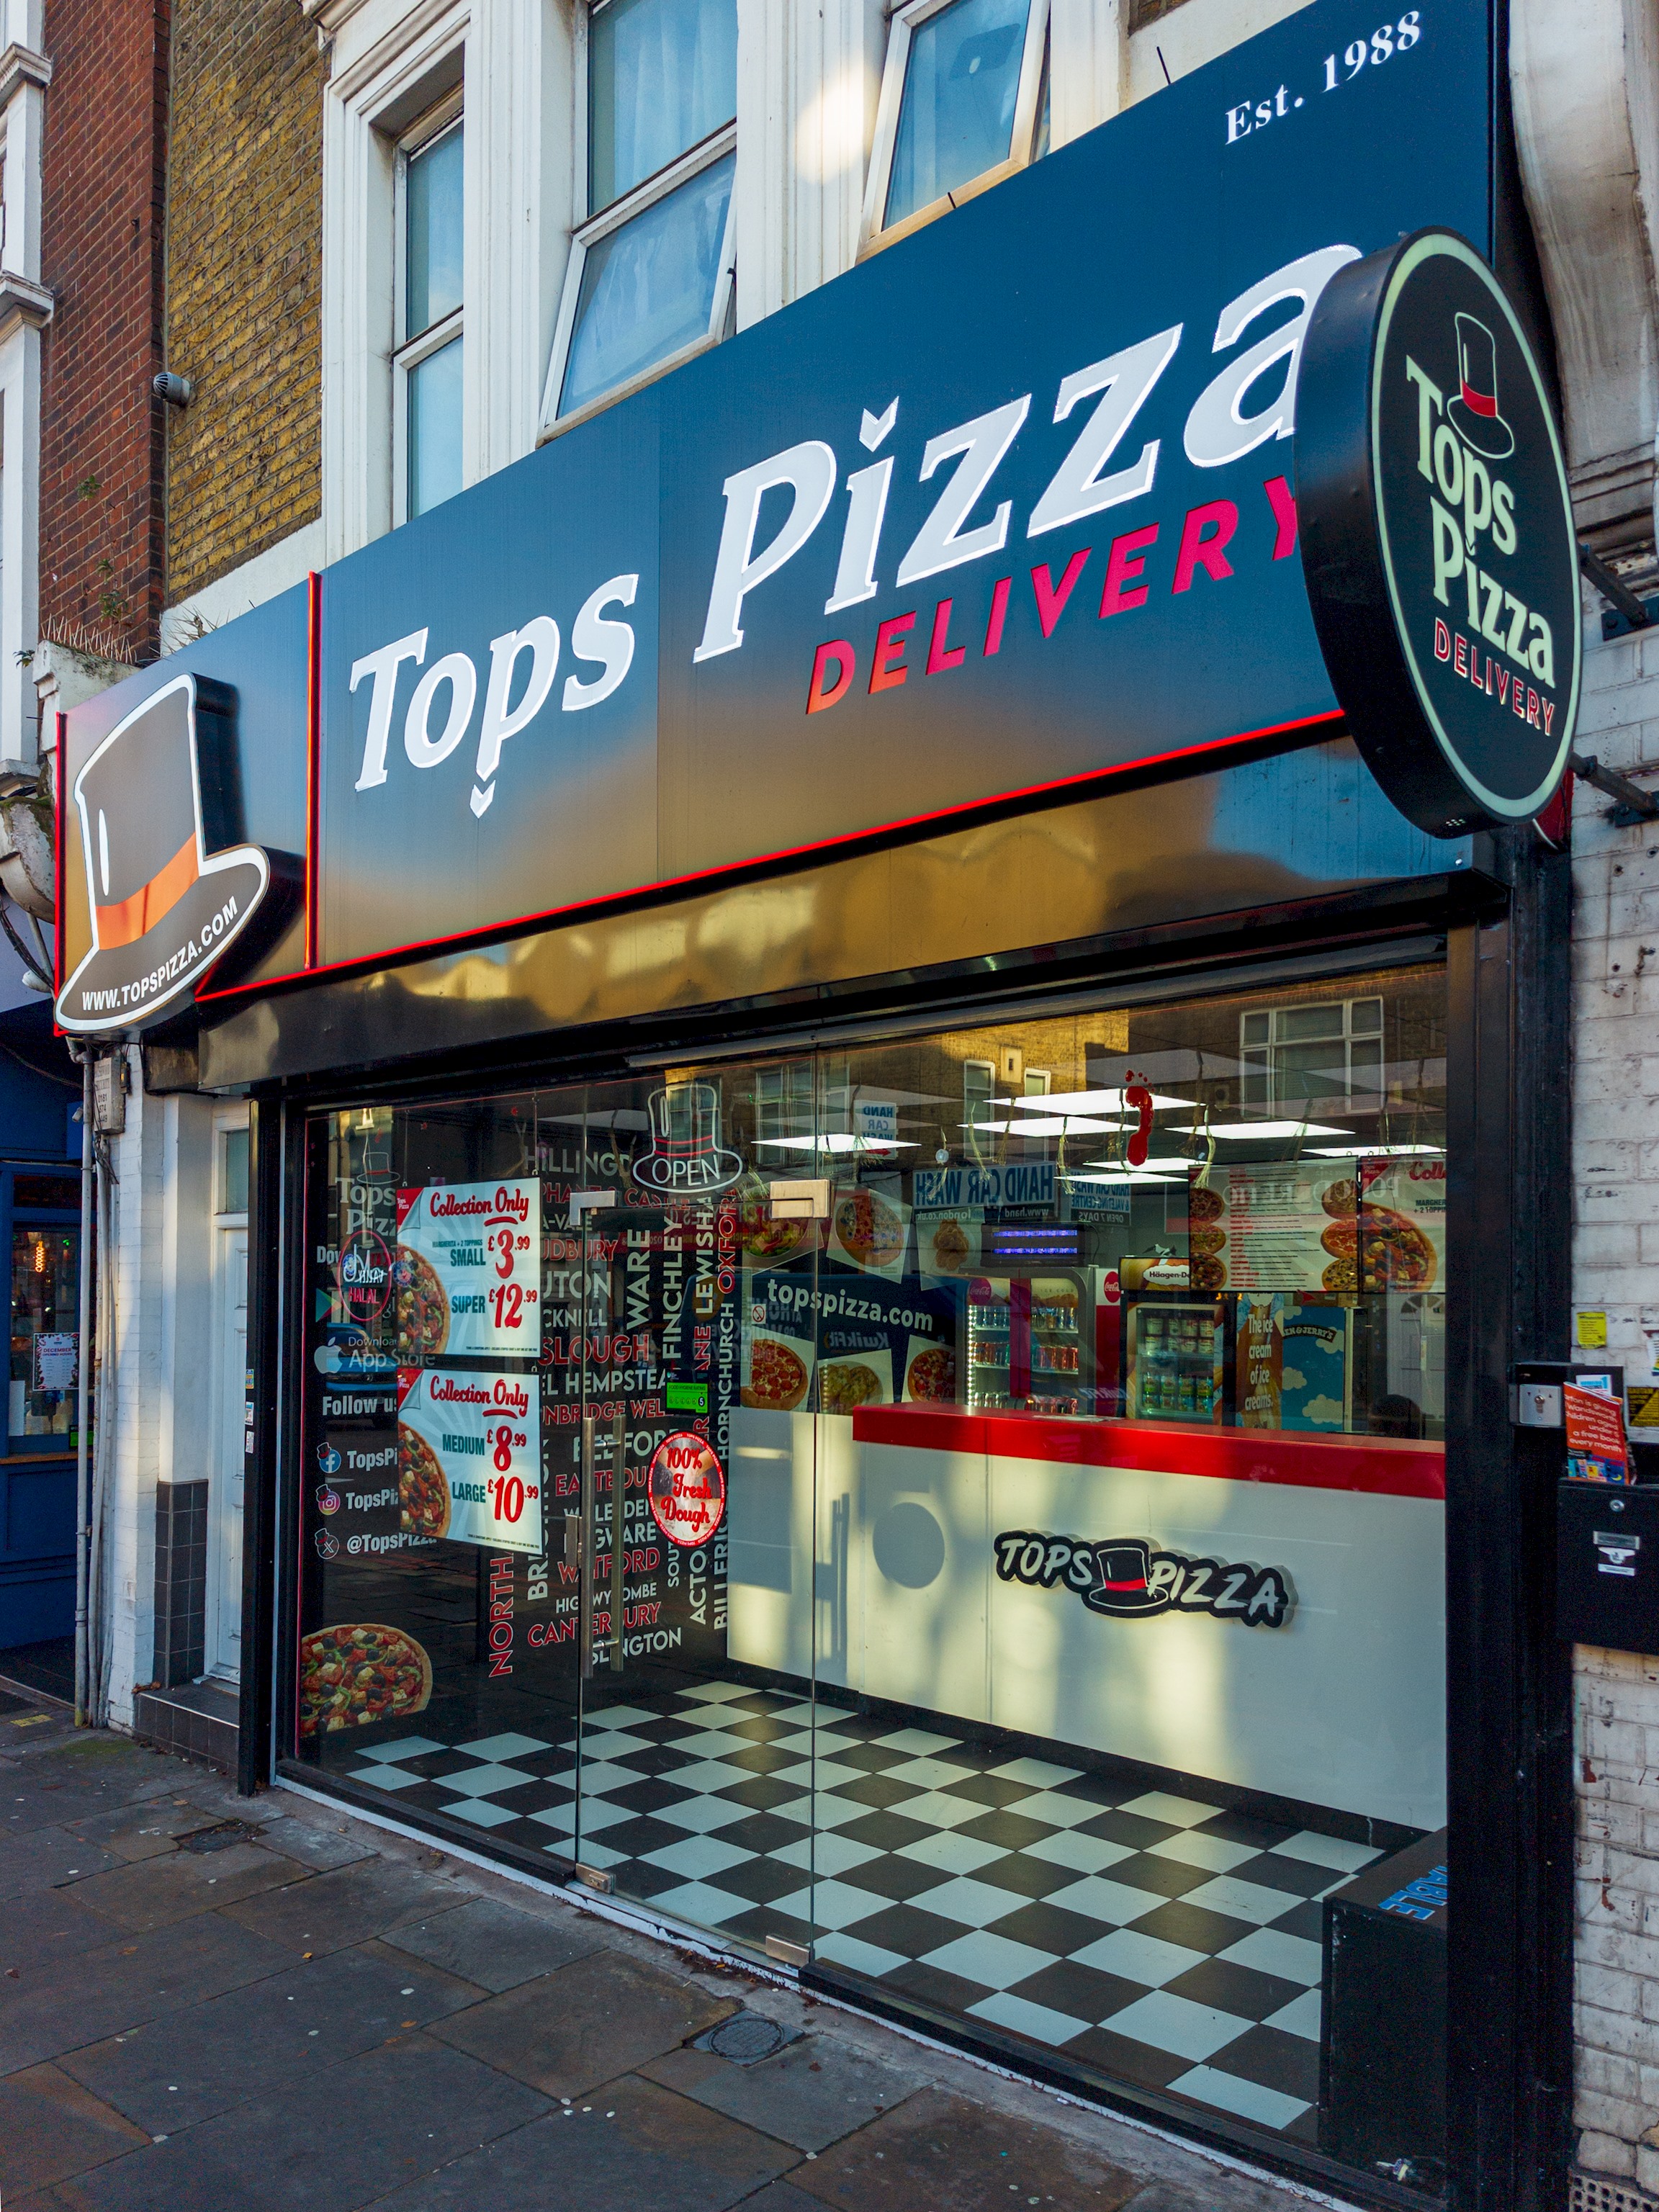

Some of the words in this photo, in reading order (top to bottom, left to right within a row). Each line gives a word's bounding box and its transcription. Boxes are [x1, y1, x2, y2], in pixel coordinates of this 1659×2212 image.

[1225, 84, 1305, 145] Est.
[1322, 11, 1421, 92] 1988
[1406, 354, 1515, 555] Tops
[349, 574, 639, 818] Tops
[693, 244, 1362, 663] Pizza
[1430, 496, 1556, 688] Pizza
[1434, 616, 1555, 736] DELIVERY
[82, 896, 238, 1011] WWW.TOPSPIZZA.COM
[652, 1155, 720, 1187] OPEN
[335, 1177, 396, 1210] Tops
[430, 1191, 493, 1218] Collection
[495, 1187, 529, 1222] Only
[450, 1248, 486, 1267] SMALL
[349, 1286, 380, 1304] HALAL
[626, 1229, 650, 1330] WARE
[662, 1215, 683, 1359] FINCHLEY
[451, 1295, 485, 1313] SUPER
[768, 1279, 933, 1331] topspizza.com
[1248, 1314, 1262, 1334] The
[1263, 1315, 1273, 1333] ice
[349, 1351, 387, 1372] App
[538, 1334, 649, 1365] SLOUGH
[1249, 1344, 1272, 1359] cream
[717, 1303, 734, 1460] HORNCHURCH
[1250, 1364, 1259, 1385] of
[1259, 1364, 1269, 1383] ice
[323, 1395, 377, 1416] Follow
[430, 1375, 491, 1403] Collection
[493, 1380, 529, 1417] Only
[543, 1401, 625, 1425] NBRIDGE
[630, 1398, 674, 1419] WEL
[443, 1434, 485, 1455] MEDIUM
[667, 1447, 702, 1469] 100%
[452, 1482, 486, 1503] LARGE
[673, 1473, 712, 1499] Fresh
[660, 1496, 710, 1532] Dough
[689, 1544, 707, 1625] ACTO
[1002, 1538, 1092, 1586] TOPS
[1147, 1560, 1279, 1617] PIZZA
[556, 1596, 579, 1614] HIG
[593, 1582, 657, 1606] WYOMBE
[489, 1552, 513, 1678] NORTH
